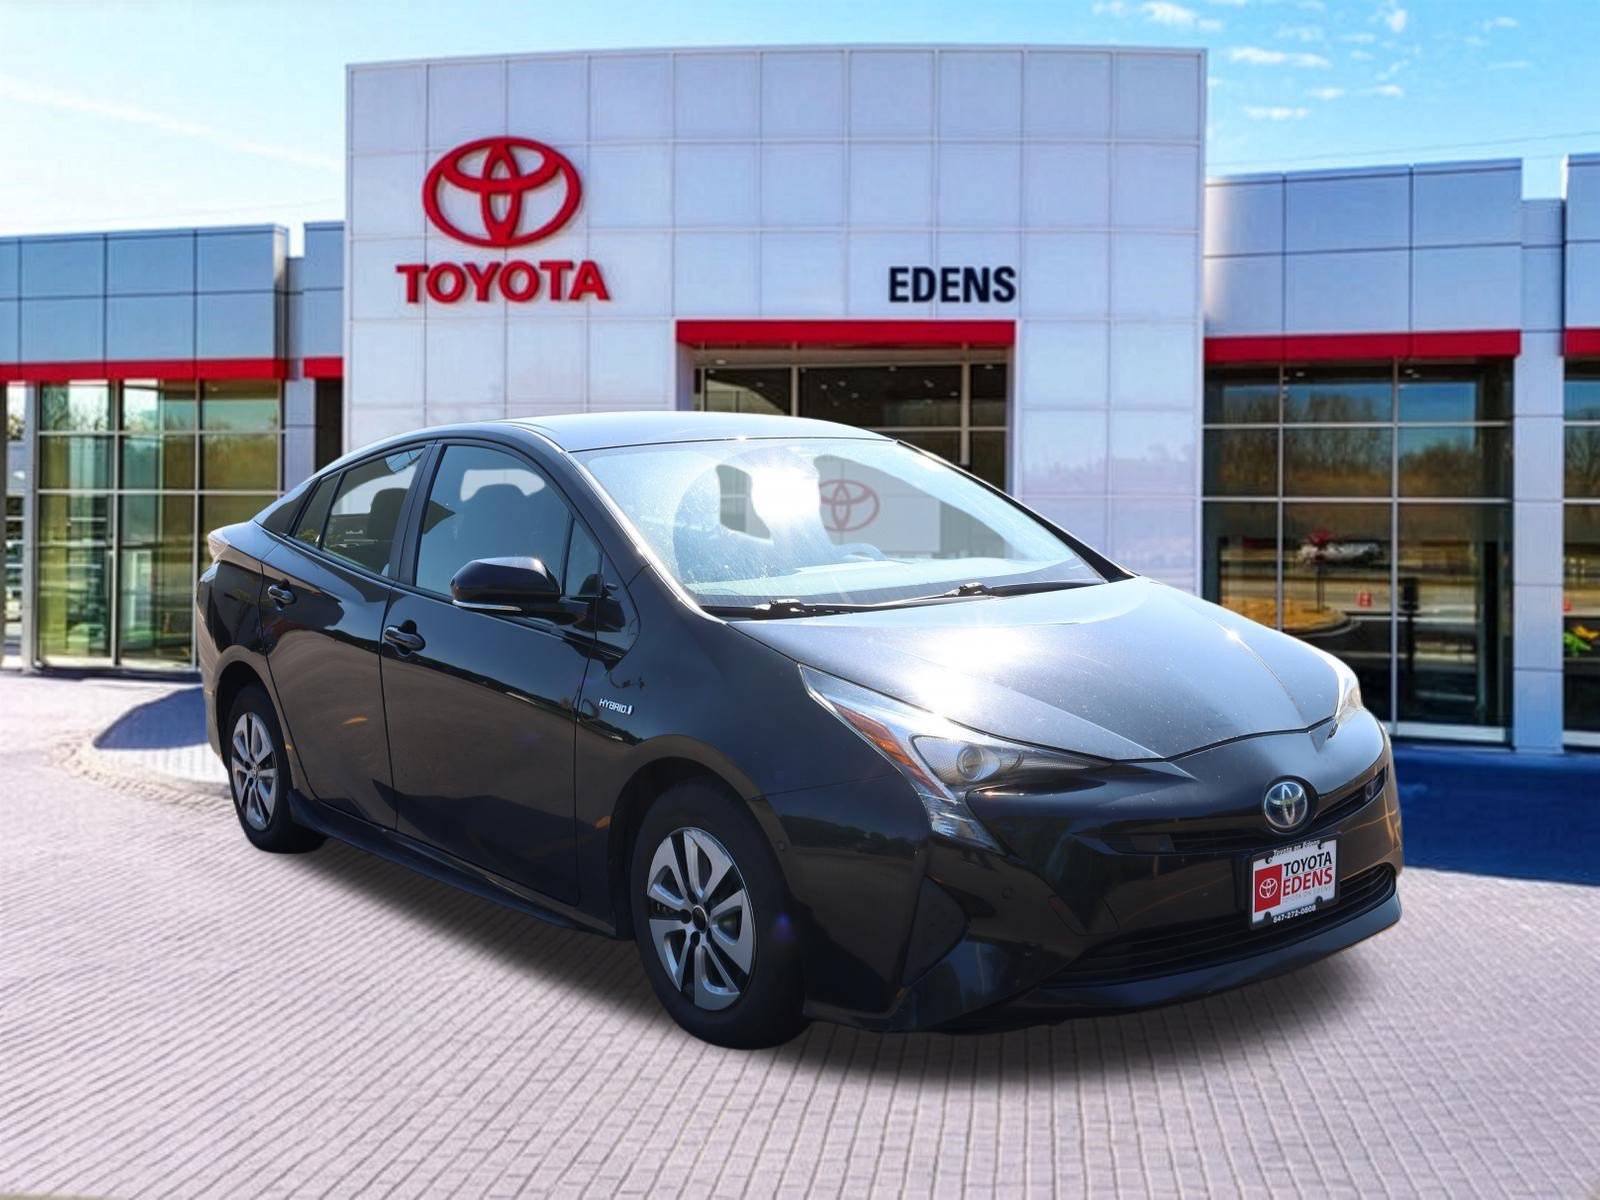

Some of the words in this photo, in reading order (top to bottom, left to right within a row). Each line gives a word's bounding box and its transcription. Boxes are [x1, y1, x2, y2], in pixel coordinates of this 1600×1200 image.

[396, 260, 611, 304] TOYOTA
[888, 266, 1017, 303] EDENS
[599, 698, 627, 714] HYBRID
[1284, 851, 1332, 877] TOYOTA
[1282, 867, 1332, 897] EDENS
